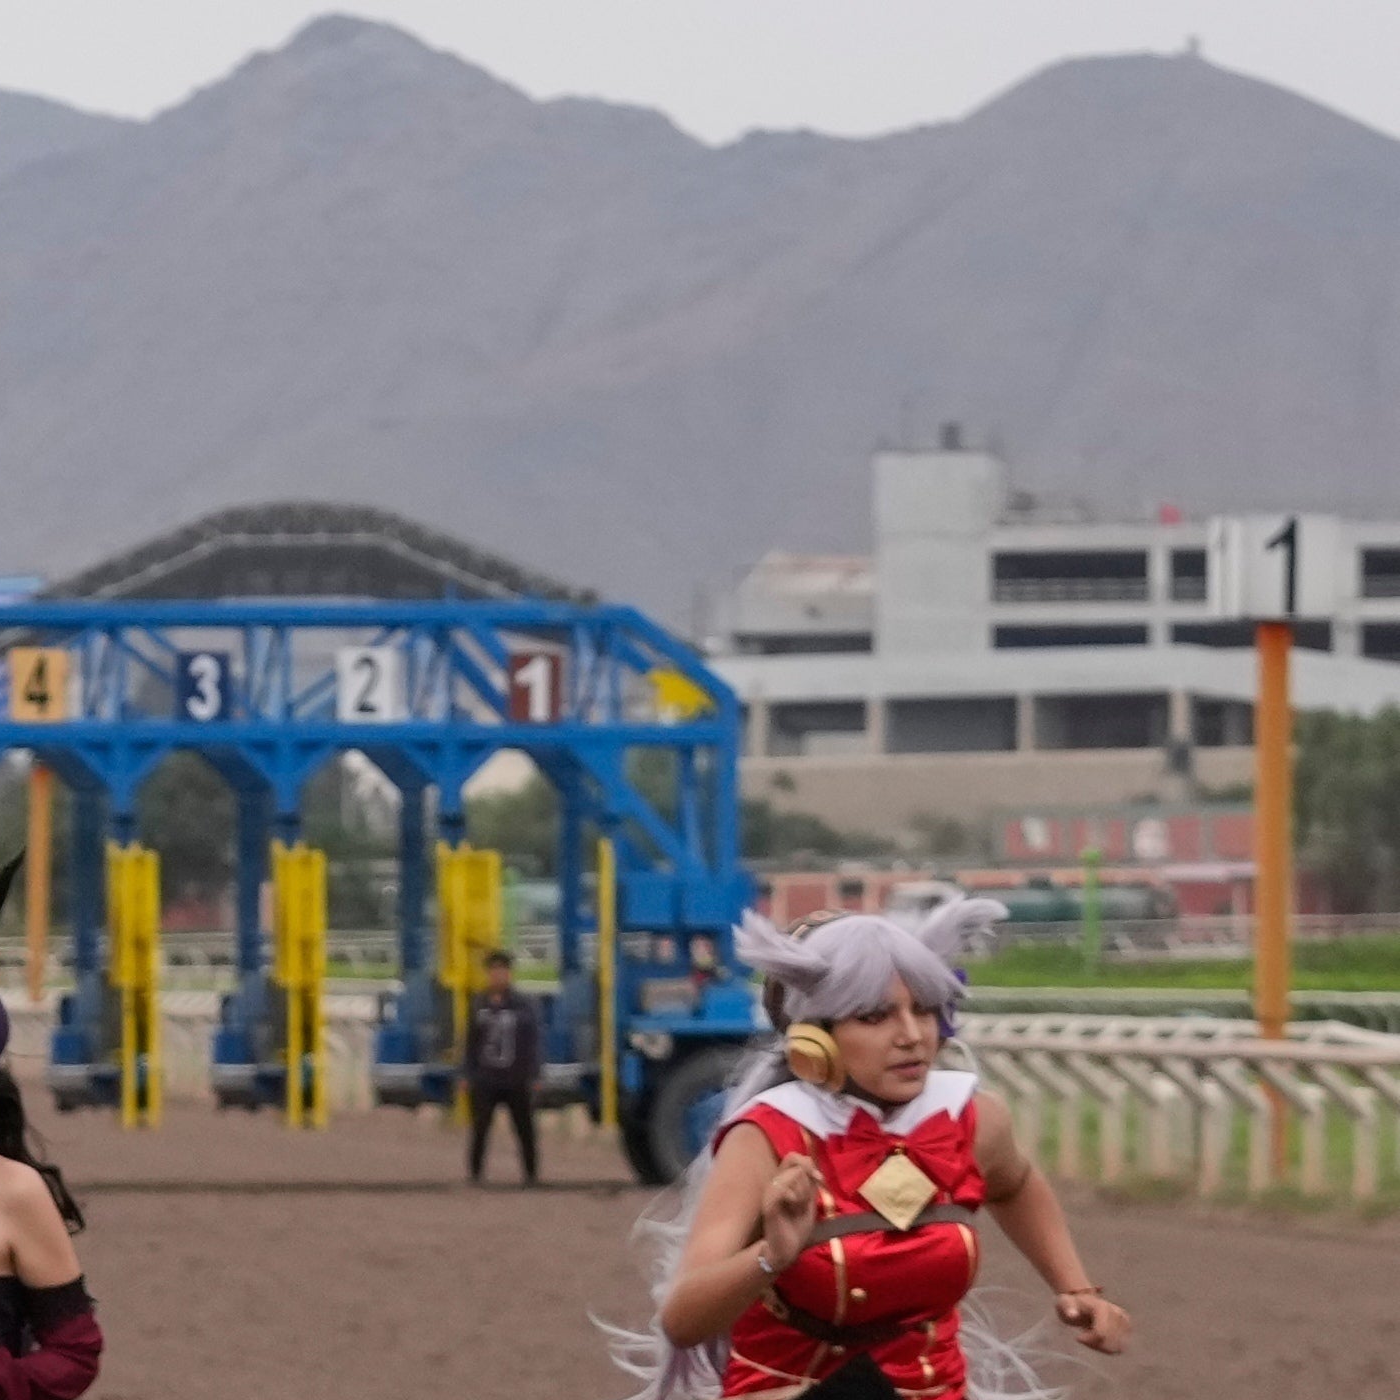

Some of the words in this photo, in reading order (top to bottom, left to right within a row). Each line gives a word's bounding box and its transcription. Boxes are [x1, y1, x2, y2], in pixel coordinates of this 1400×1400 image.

[1263, 516, 1297, 615] 1
[26, 655, 50, 713] 4
[185, 653, 222, 721] 3
[353, 656, 380, 714] 2
[514, 655, 551, 721] 1
